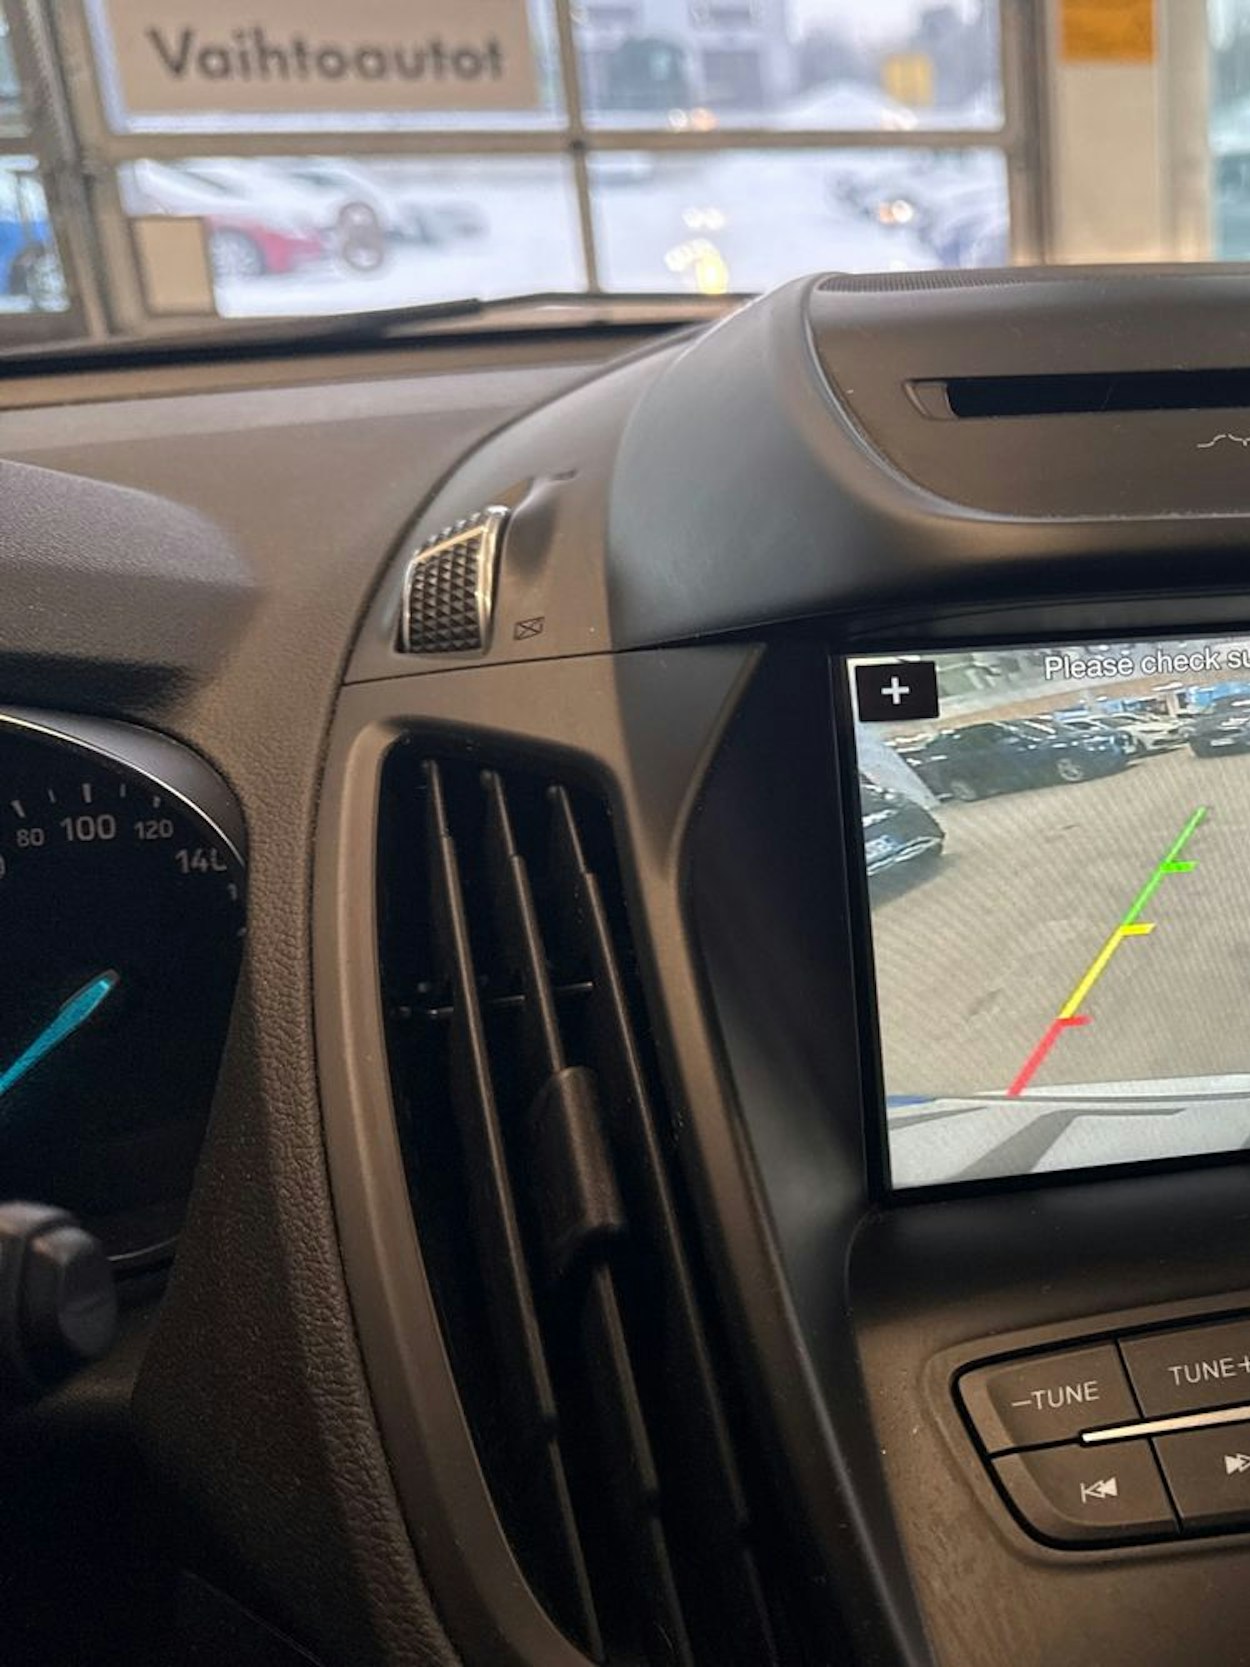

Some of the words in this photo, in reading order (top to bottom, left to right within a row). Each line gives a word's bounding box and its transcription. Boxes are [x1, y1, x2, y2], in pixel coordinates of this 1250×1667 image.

[146, 24, 503, 81] Vaihtoautot
[1044, 656, 1134, 680] Please
[1141, 645, 1221, 674] check
[16, 828, 45, 847] 80
[60, 815, 116, 841] 100
[134, 819, 173, 840] 120
